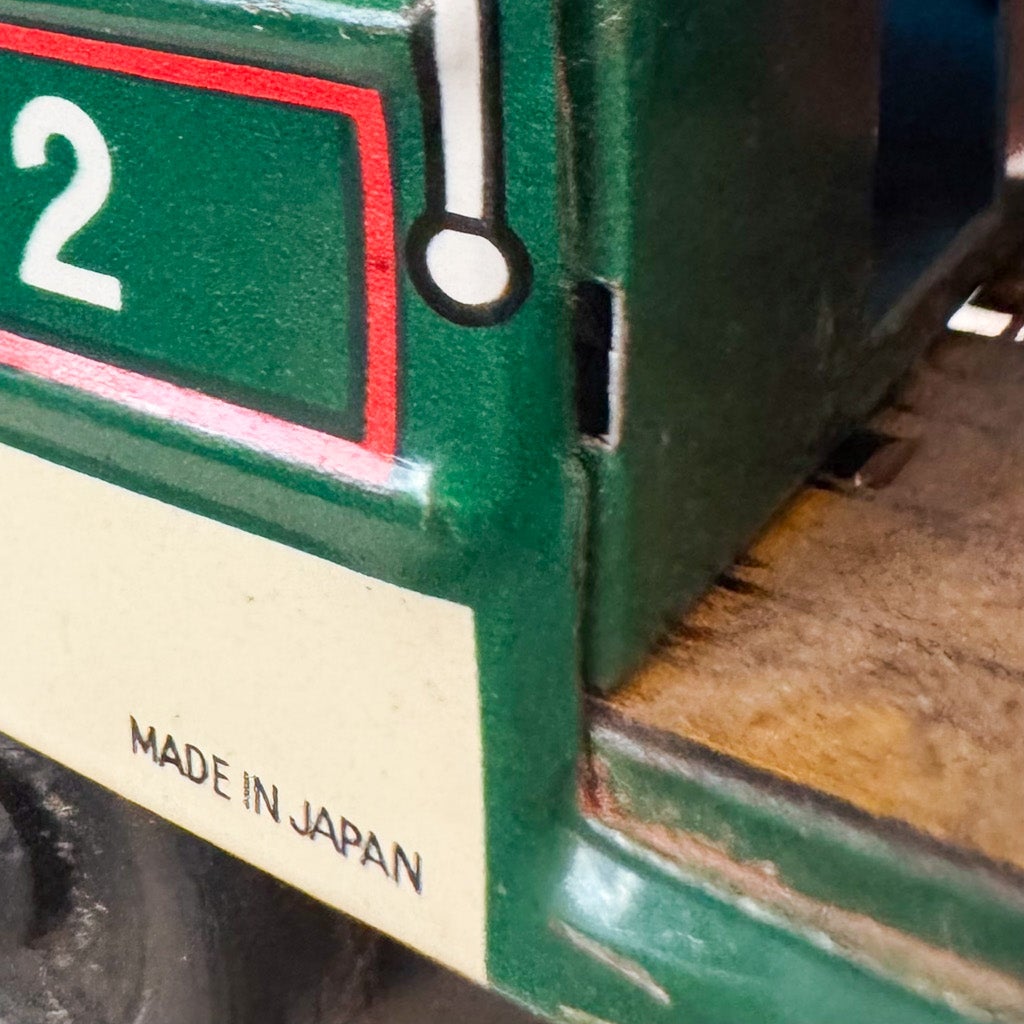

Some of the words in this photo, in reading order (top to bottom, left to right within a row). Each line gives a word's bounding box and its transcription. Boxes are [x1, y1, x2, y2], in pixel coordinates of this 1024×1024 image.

[129, 714, 231, 801] MADE
[243, 770, 281, 824] IN
[288, 800, 423, 896] JAPAN
